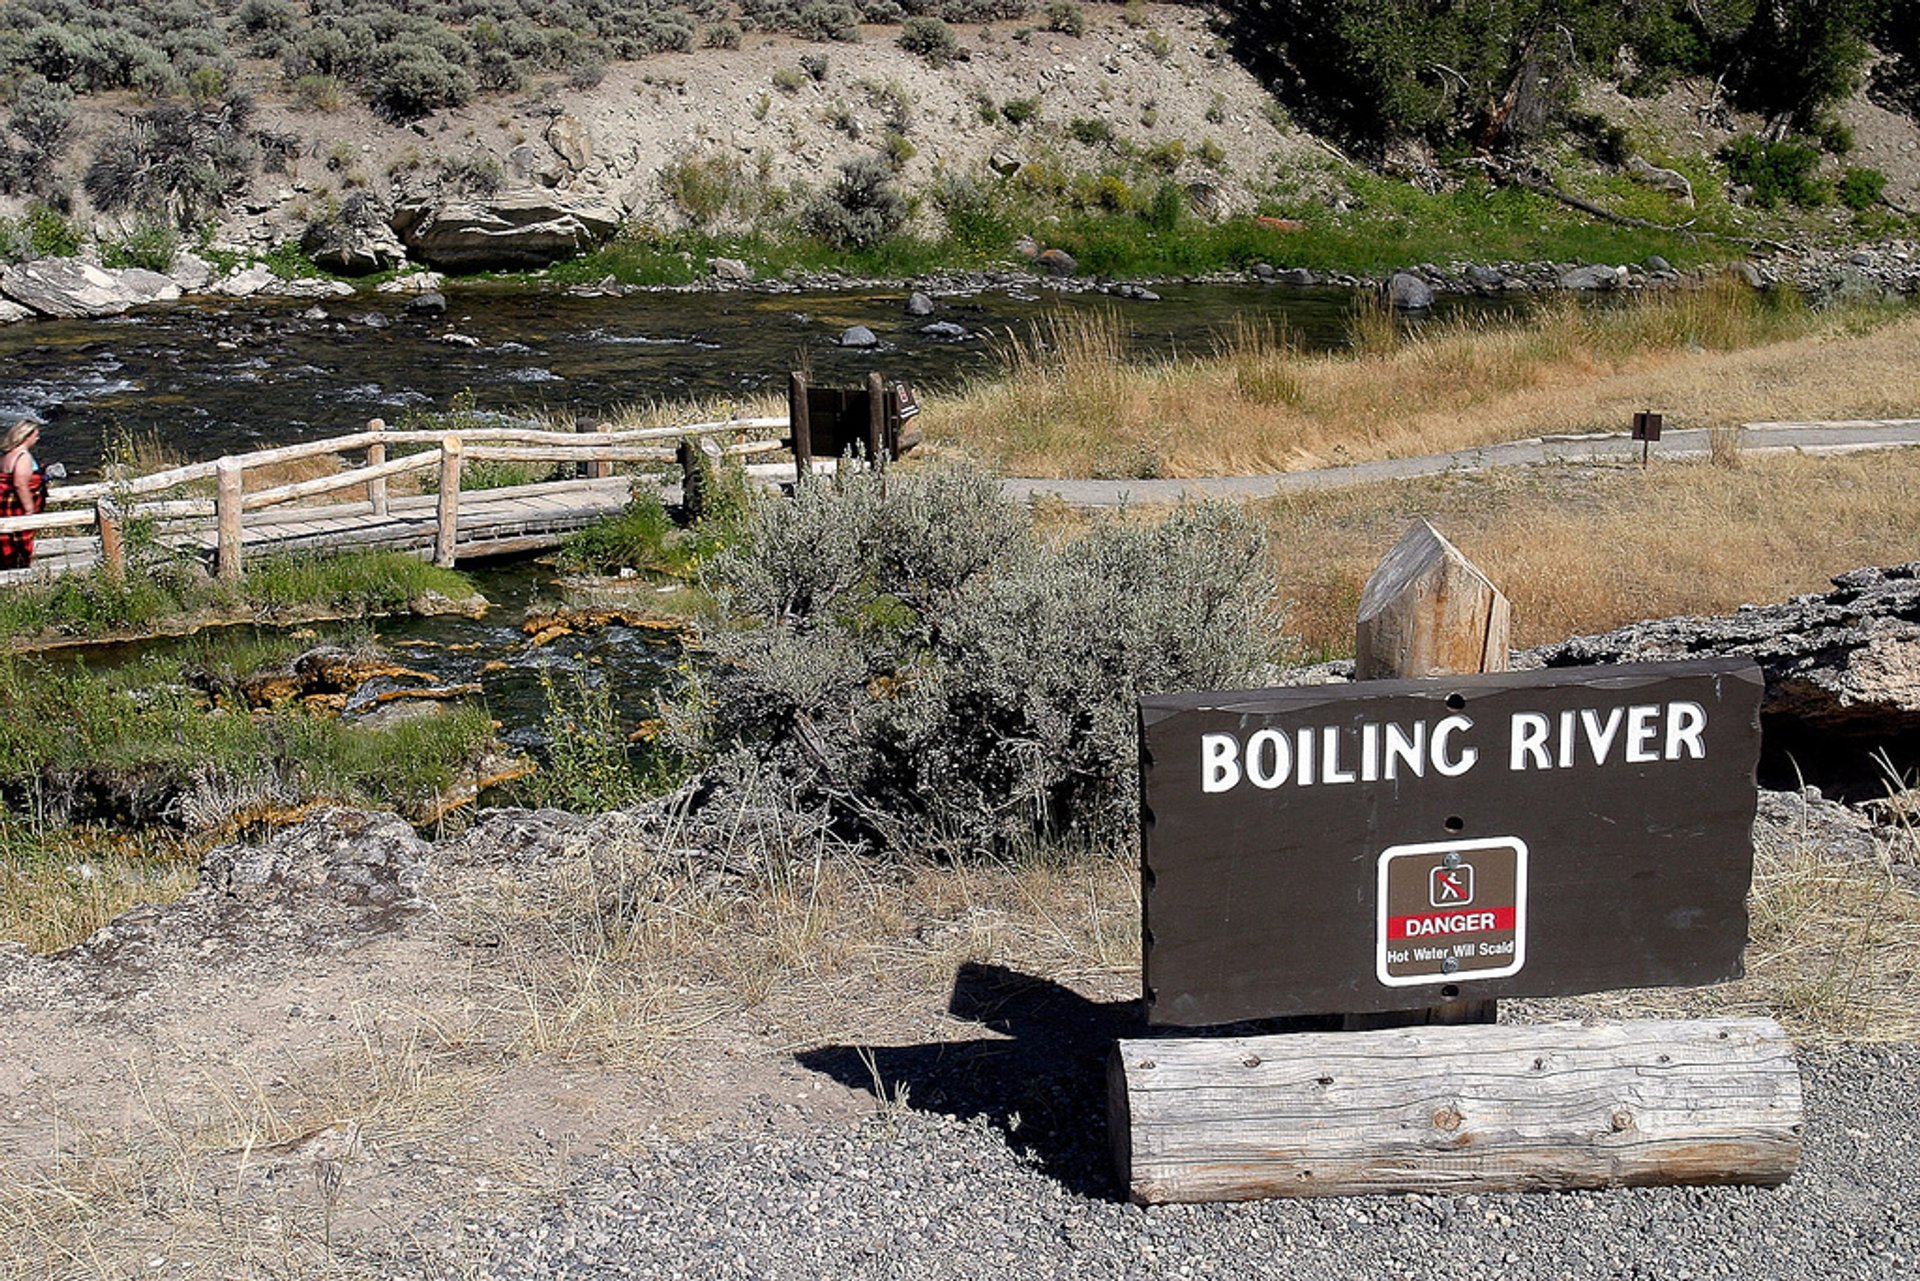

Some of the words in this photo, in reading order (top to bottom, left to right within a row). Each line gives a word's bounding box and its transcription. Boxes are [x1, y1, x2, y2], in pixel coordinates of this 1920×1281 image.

[1201, 713, 1479, 794] BOILING
[1509, 702, 1706, 771] RIVER
[1405, 912, 1496, 937] DANGER
[1387, 950, 1409, 963] Hot
[1414, 948, 1448, 961] Water
[1453, 944, 1475, 957] Will
[1479, 940, 1514, 955] Scald
